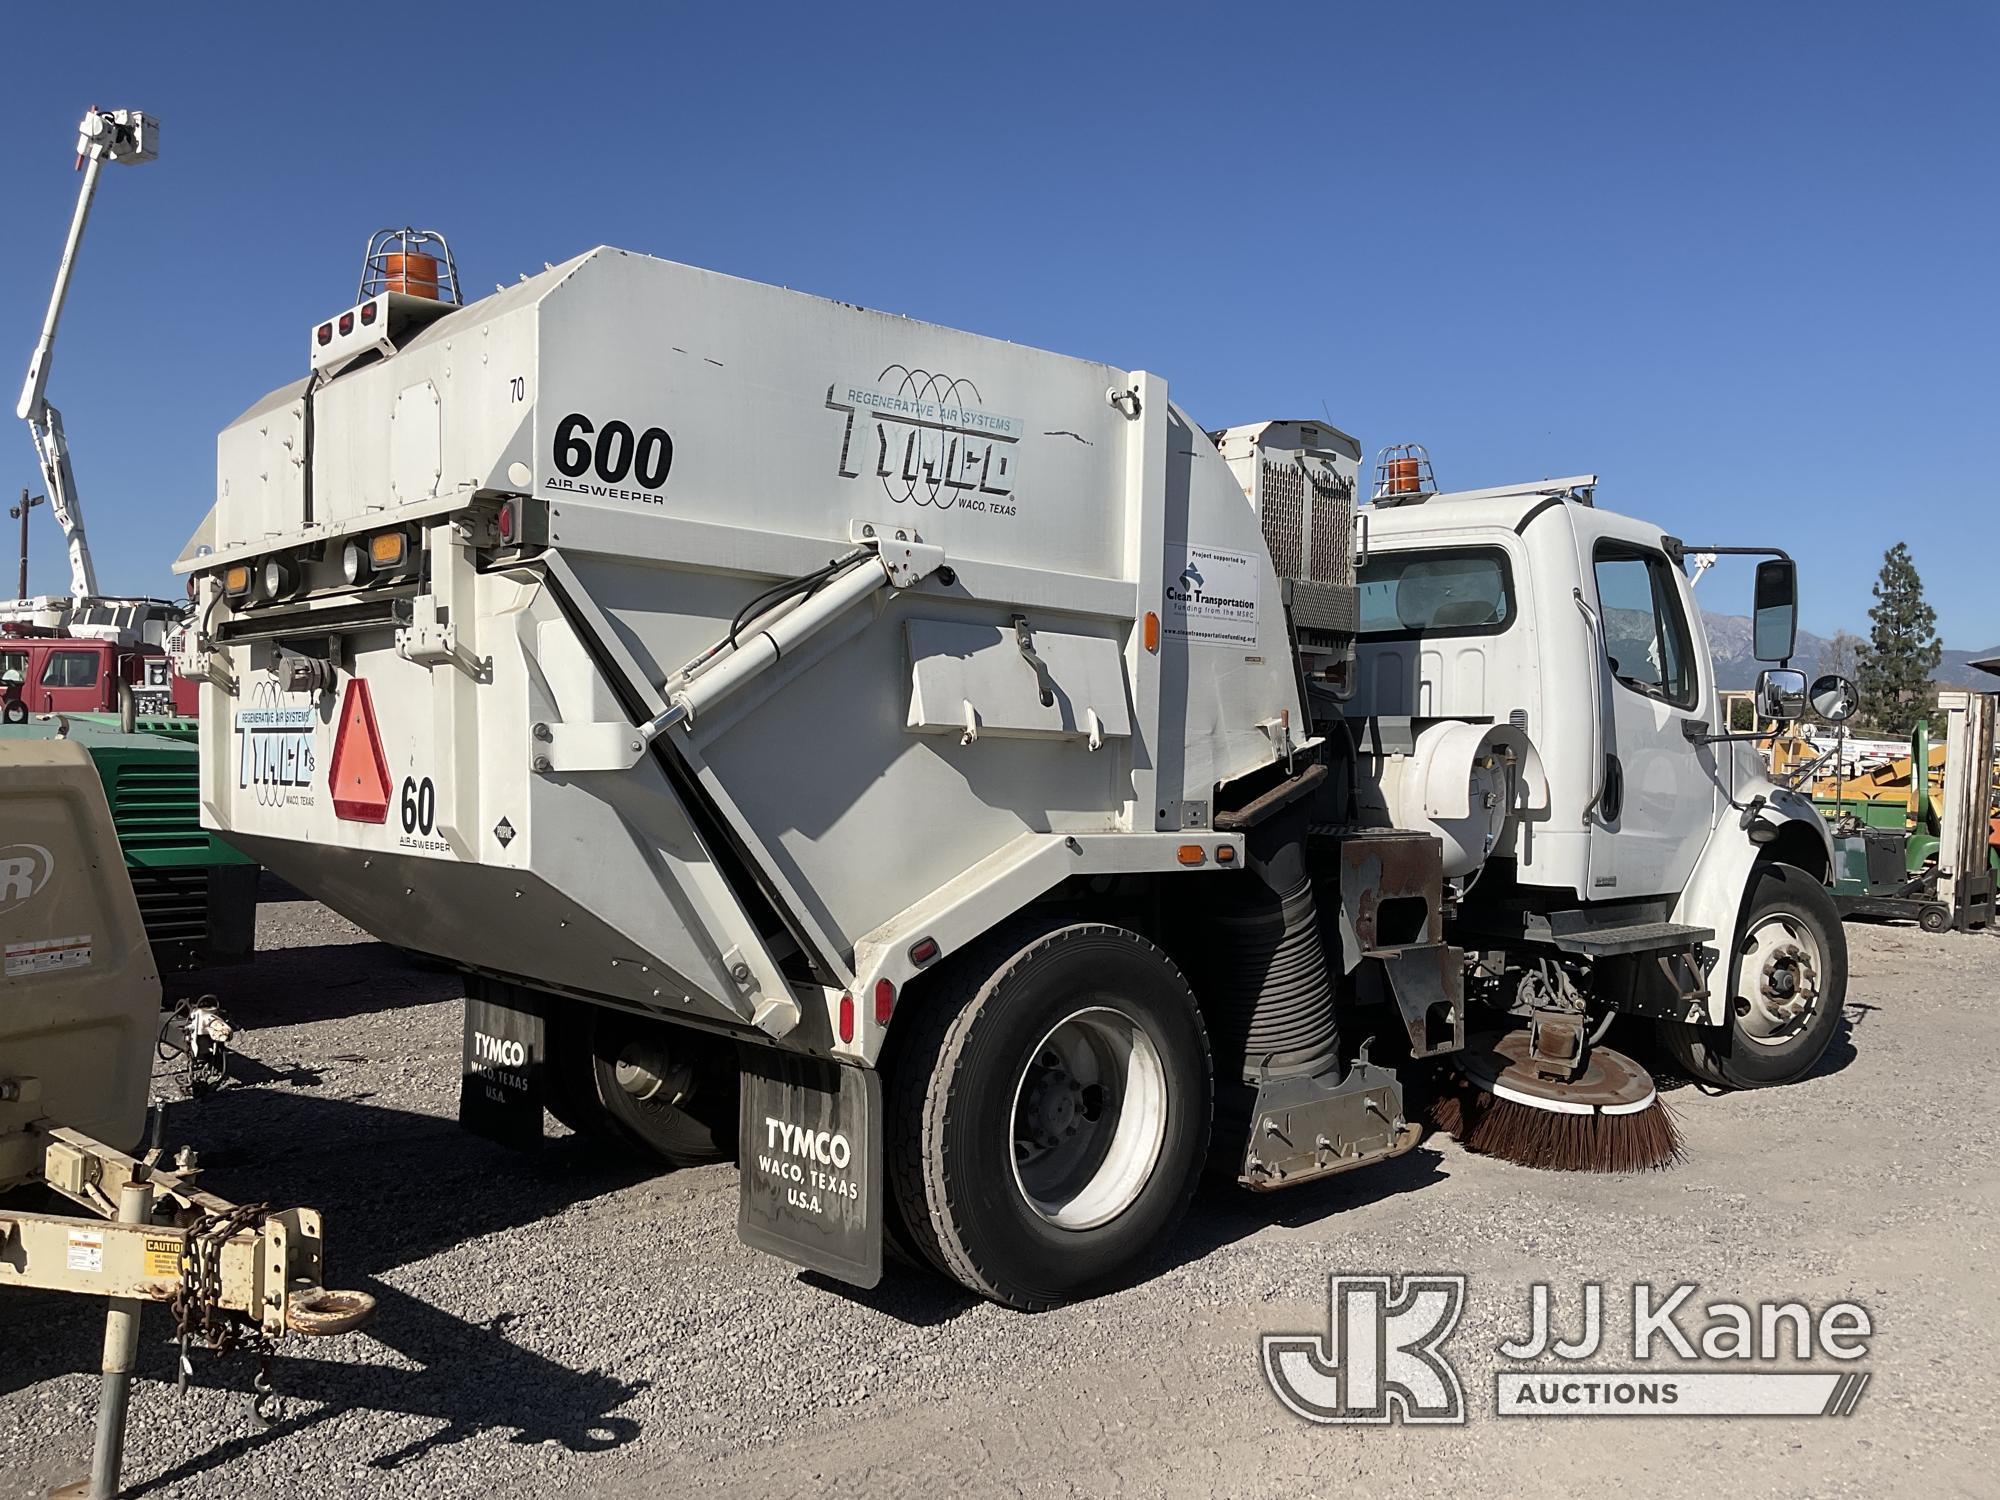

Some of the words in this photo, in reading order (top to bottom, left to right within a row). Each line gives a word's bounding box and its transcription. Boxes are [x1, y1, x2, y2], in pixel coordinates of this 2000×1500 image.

[510, 376, 525, 404] 70
[848, 388, 934, 418] REGENERATIVE
[939, 407, 957, 422] AIR
[962, 411, 1011, 432] SYSTEMS
[553, 413, 673, 490] 600
[547, 477, 574, 489] AIR
[578, 484, 664, 505] SWEEPER
[958, 497, 987, 513] WACO,
[988, 502, 1017, 516] TEXAS
[1191, 550, 1212, 560] Project
[1213, 554, 1239, 564] supported
[1240, 557, 1246, 565] by
[1166, 586, 1192, 602] Clean
[1193, 589, 1254, 610] Transportation
[1174, 603, 1202, 614] Funding
[1204, 606, 1221, 615] from
[1223, 608, 1234, 616] the
[1236, 610, 1254, 619] MSRC
[242, 711, 274, 724] REGENERATIVE
[276, 711, 284, 723] AIR
[285, 710, 309, 723] SYSTEMS
[300, 796, 315, 807] TEXAS
[401, 776, 444, 839] 60
[1819, 809, 1846, 817] EERE
[399, 836, 411, 845] AIR
[412, 839, 451, 852] SWEEPER
[475, 1031, 524, 1067] TYMCO
[471, 1060, 496, 1081] WACO,
[499, 1071, 528, 1091] TEXAS
[765, 1117, 851, 1169] TYMCO
[758, 1154, 805, 1185] WACO,
[810, 1170, 858, 1200] TEXAS
[787, 1187, 823, 1214] U.S.A.
[147, 1241, 183, 1252] CAUTIO
